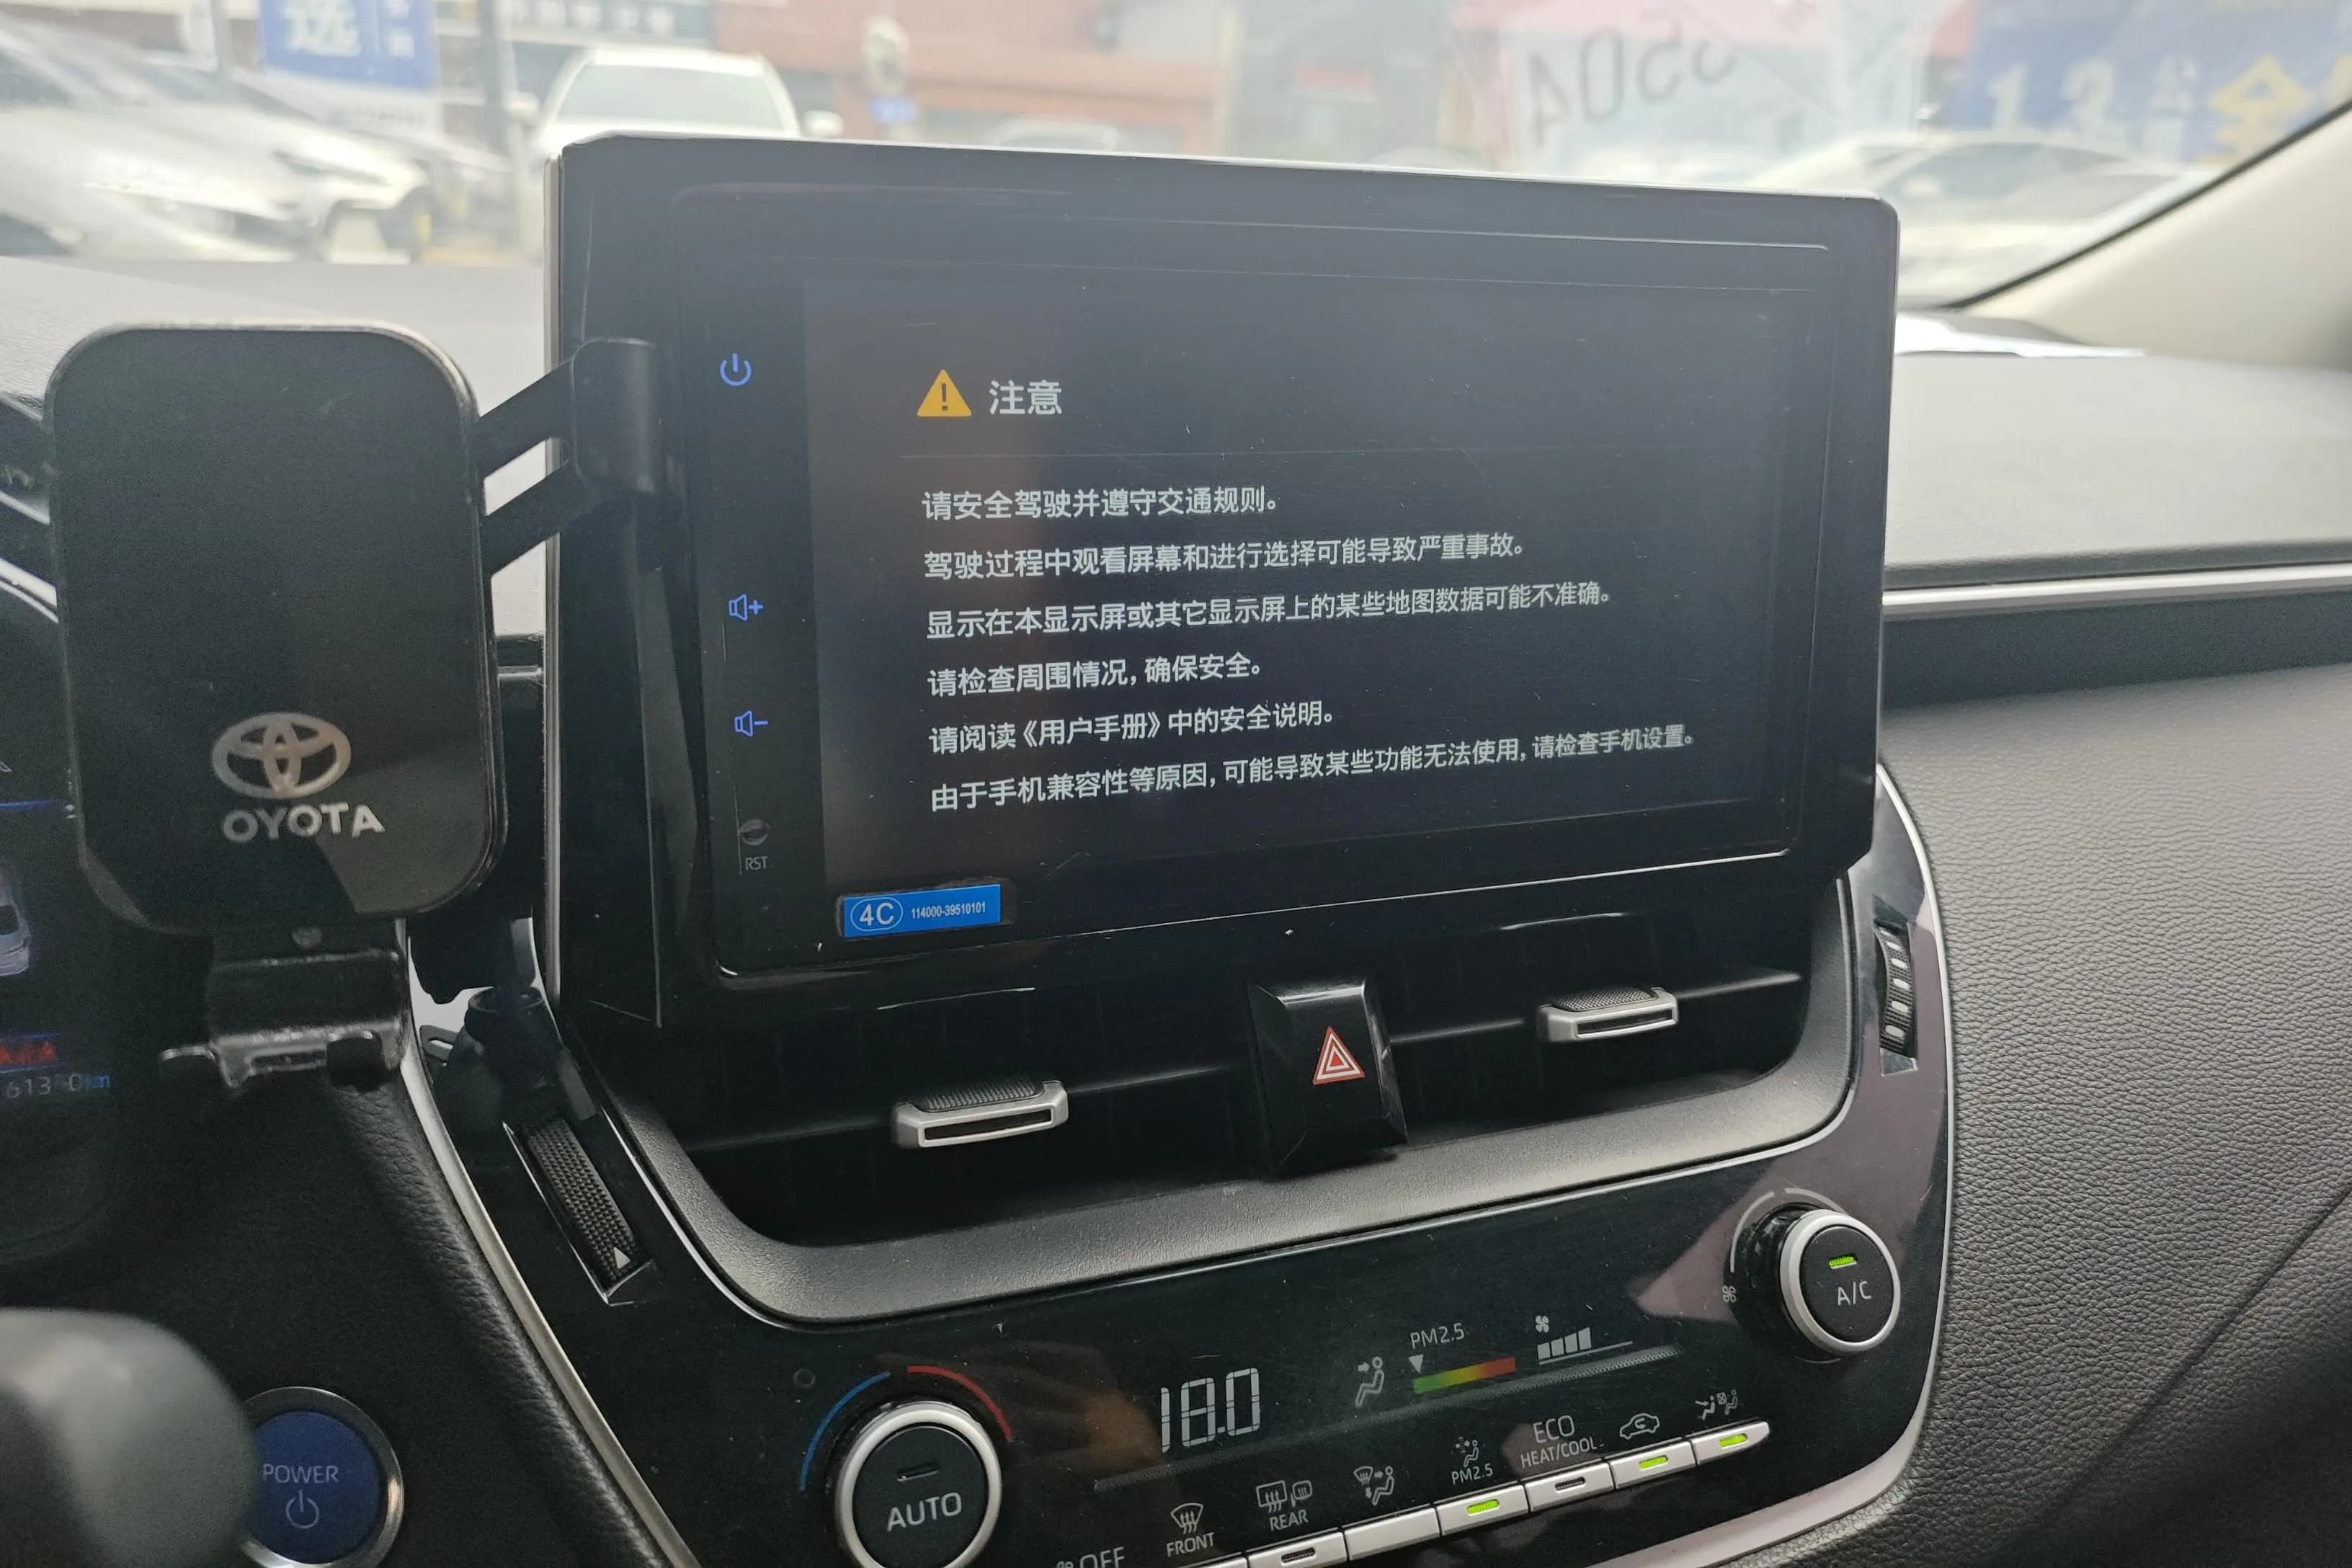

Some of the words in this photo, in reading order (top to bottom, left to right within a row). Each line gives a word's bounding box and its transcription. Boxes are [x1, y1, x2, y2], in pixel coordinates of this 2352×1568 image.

[989, 380, 1062, 416] 注意
[922, 486, 1277, 520] 请安全驾驶并遵守交通规则。
[925, 533, 1523, 580] 驾驶过程中观看屏幕和进行选择可能导致严重事故。
[927, 581, 1608, 638] 显示在本显示屏或其它显示屏上的某些地图数据可能不准确。
[929, 700, 1332, 754] 请阅读《用户手册》中的安全说明。
[223, 802, 386, 842] OYOTA
[745, 855, 768, 870] RST
[859, 902, 894, 927] 4C
[1837, 1280, 1871, 1306] A/C
[1410, 1323, 1464, 1349] PM2.5
[1160, 1368, 1260, 1453] 18.0
[1533, 1415, 1575, 1443] ECO
[1520, 1436, 1598, 1469] HEAT/COOL
[263, 1464, 339, 1484] POWER
[1451, 1464, 1493, 1485] PM2.5
[887, 1493, 962, 1532] AUTO
[1270, 1510, 1309, 1531] REAR
[1080, 1546, 1125, 1568] OFF
[1166, 1531, 1215, 1557] FRONT
